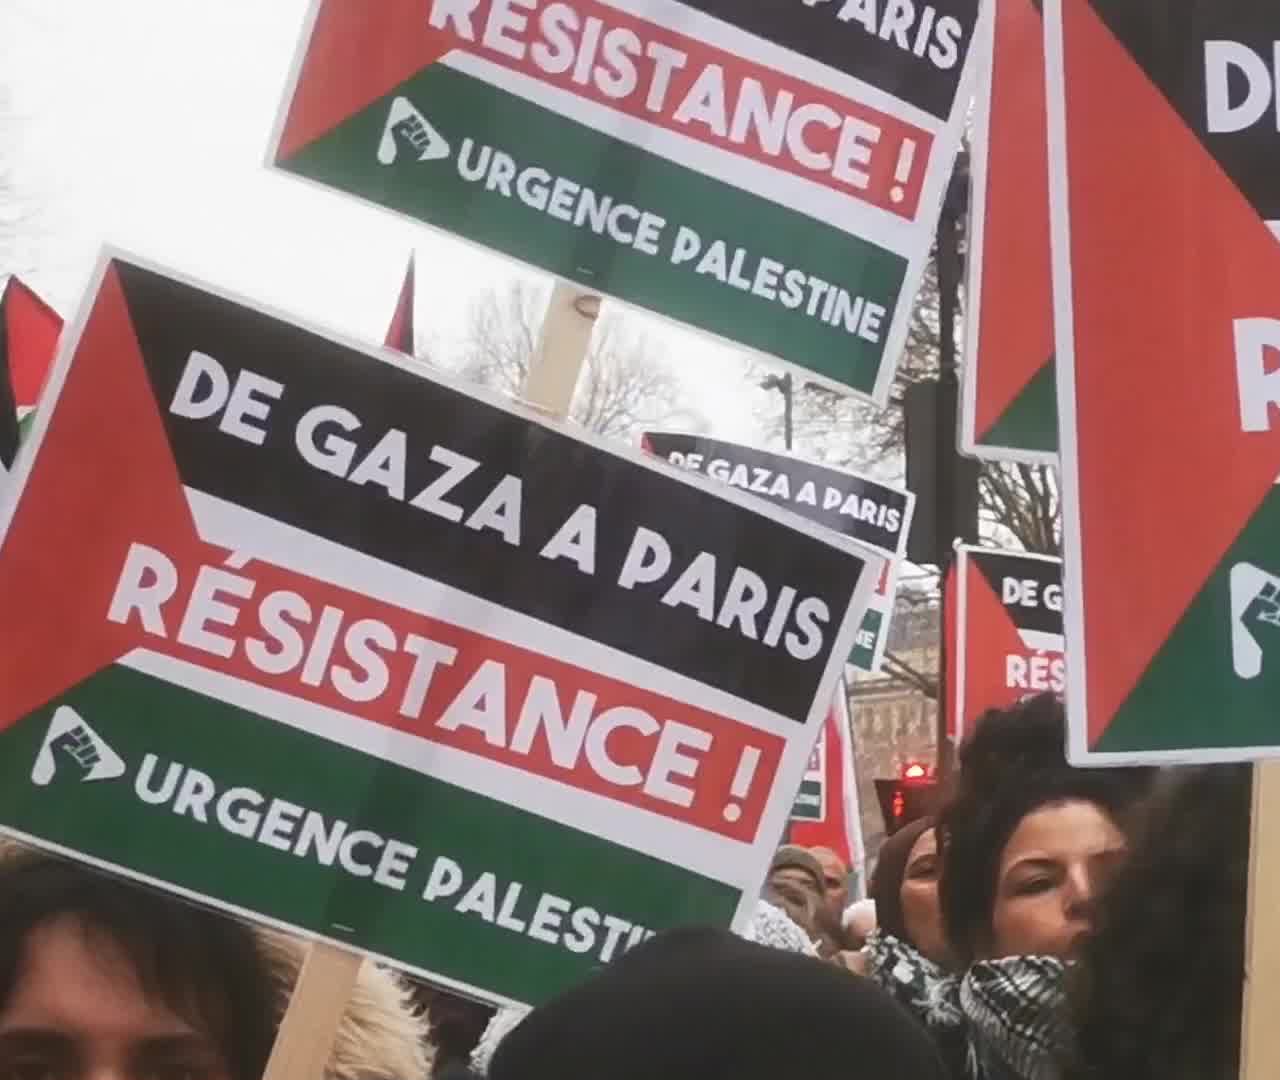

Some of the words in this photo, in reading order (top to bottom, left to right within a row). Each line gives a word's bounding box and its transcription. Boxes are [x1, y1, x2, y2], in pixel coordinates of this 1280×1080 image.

[803, 0, 962, 69] ARIS
[894, 137, 916, 203] !
[457, 139, 662, 257] URGENCE
[672, 215, 885, 344] PALESTINE
[169, 350, 285, 445] DE
[295, 404, 523, 546] GAZA
[538, 503, 597, 575] A
[617, 525, 830, 661] PARIS
[706, 459, 790, 499] GAZA
[796, 481, 817, 506] A
[823, 487, 901, 533] PARIS
[1002, 577, 1039, 607] DE
[1044, 586, 1063, 611] G
[107, 542, 713, 810] RÉSISTANCE
[723, 744, 760, 822] !
[1006, 650, 1064, 692] RÉS
[135, 753, 418, 892] URGENCE
[422, 856, 656, 963] PALESTI
